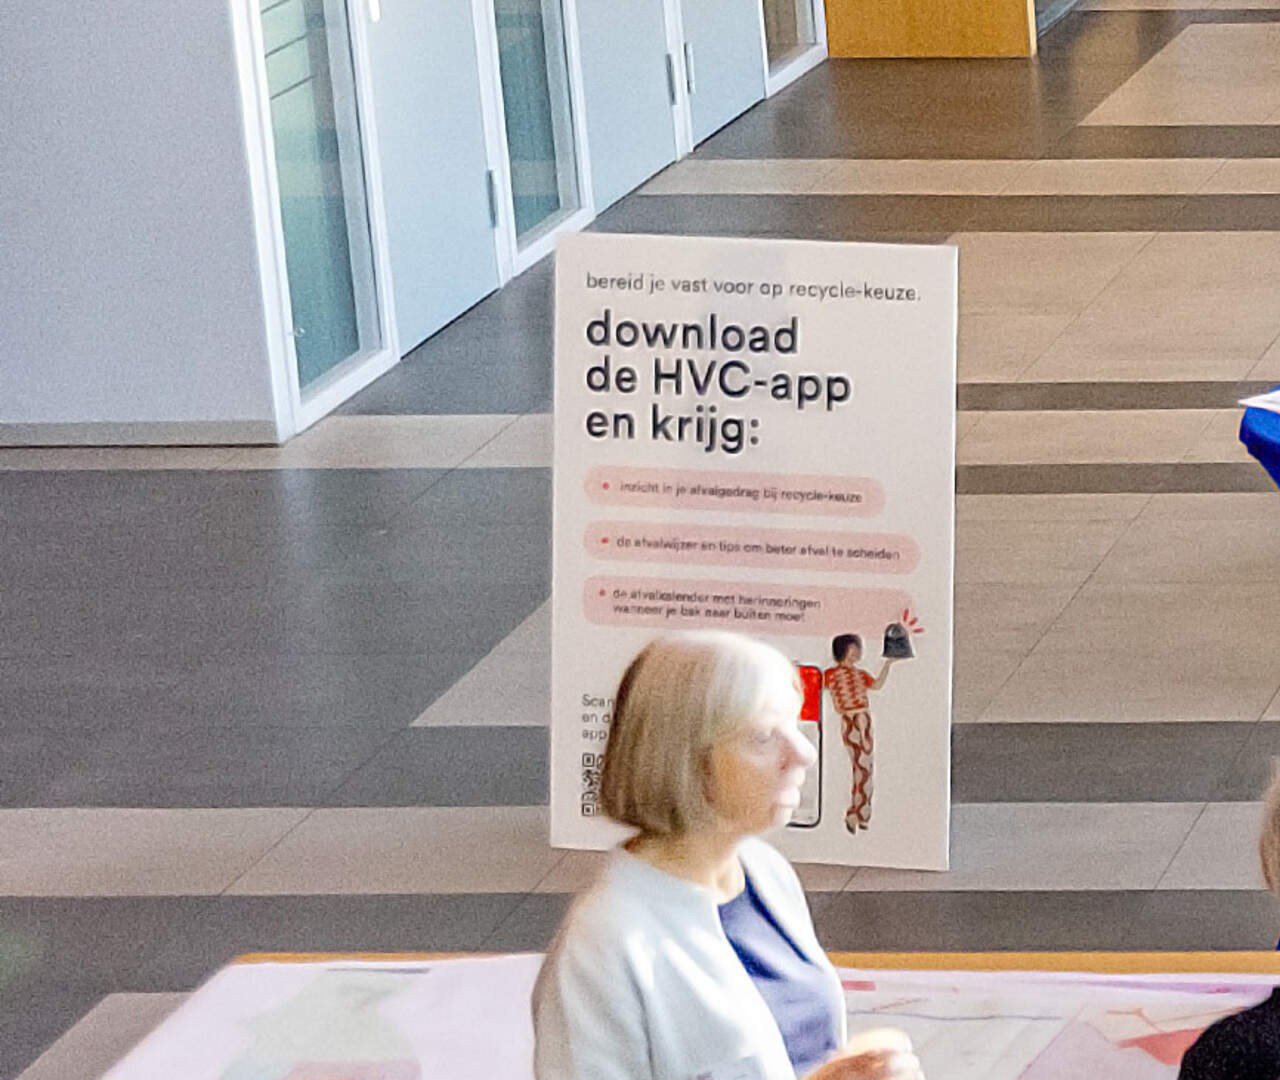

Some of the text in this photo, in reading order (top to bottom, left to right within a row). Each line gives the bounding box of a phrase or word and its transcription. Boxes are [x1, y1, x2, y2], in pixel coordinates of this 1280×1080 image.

[586, 271, 921, 301] bereid je vast voor op recycle-keuze.
[585, 309, 800, 354] download
[585, 354, 853, 412] de HVC-app
[585, 404, 761, 454] en krijg:
[620, 482, 863, 505] inzicht in je afvalgedrag bij recycle-keuze
[616, 535, 900, 560] de afvalwijzer en tips om beter afval te scheiden
[613, 588, 821, 612] de afvalkalender met herinneringen
[613, 604, 663, 616] wanneer
[665, 605, 677, 619] je
[680, 605, 700, 617] bak
[705, 607, 730, 618] naar
[734, 607, 771, 620] buiten
[582, 713, 598, 723] en
